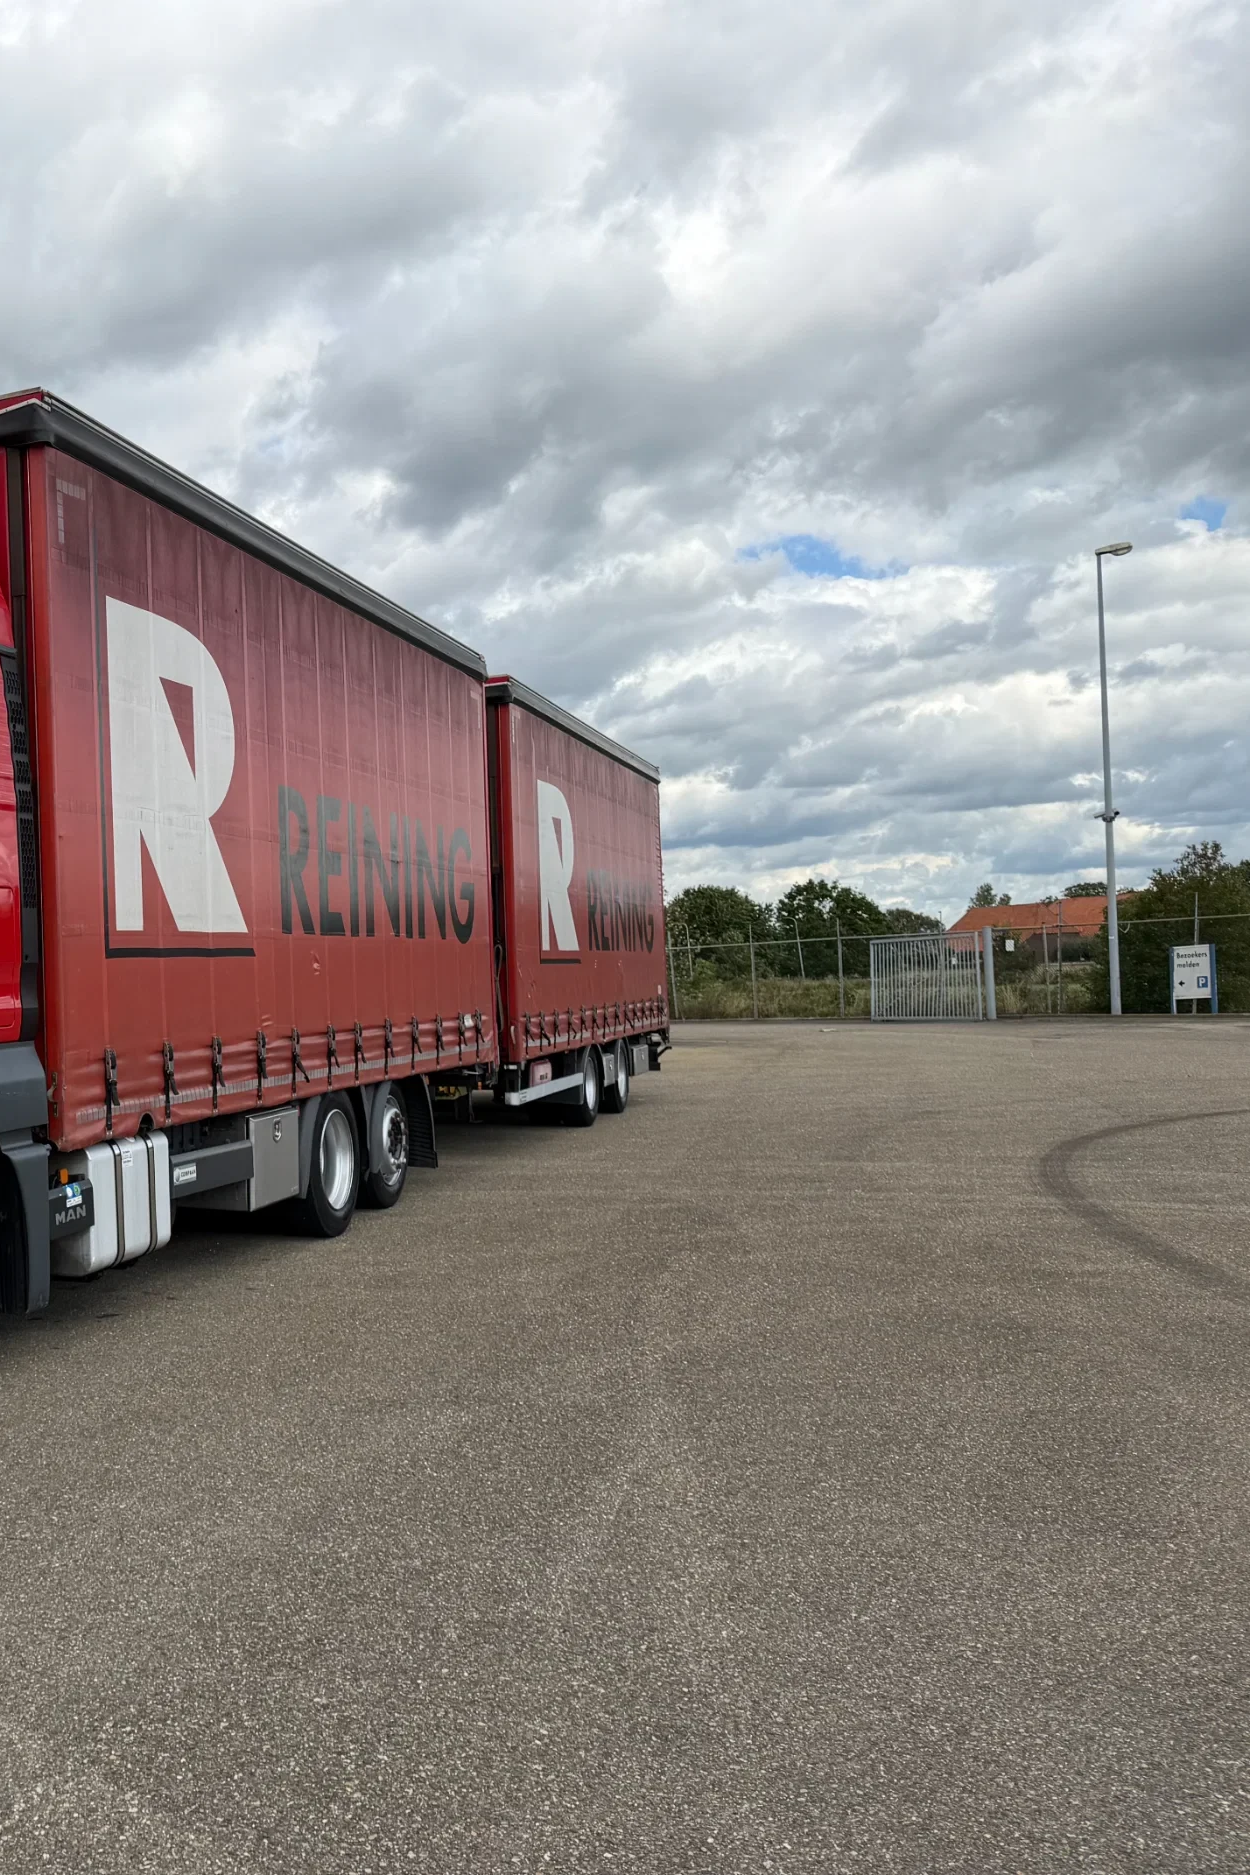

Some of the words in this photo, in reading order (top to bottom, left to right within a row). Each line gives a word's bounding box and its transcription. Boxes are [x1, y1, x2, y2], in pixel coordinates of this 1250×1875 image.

[105, 595, 249, 933] R
[277, 784, 475, 945] REINING
[537, 779, 580, 952] R
[586, 867, 655, 954] REINING
[1176, 951, 1208, 959] Bezoekers
[55, 1204, 86, 1226] MAN
